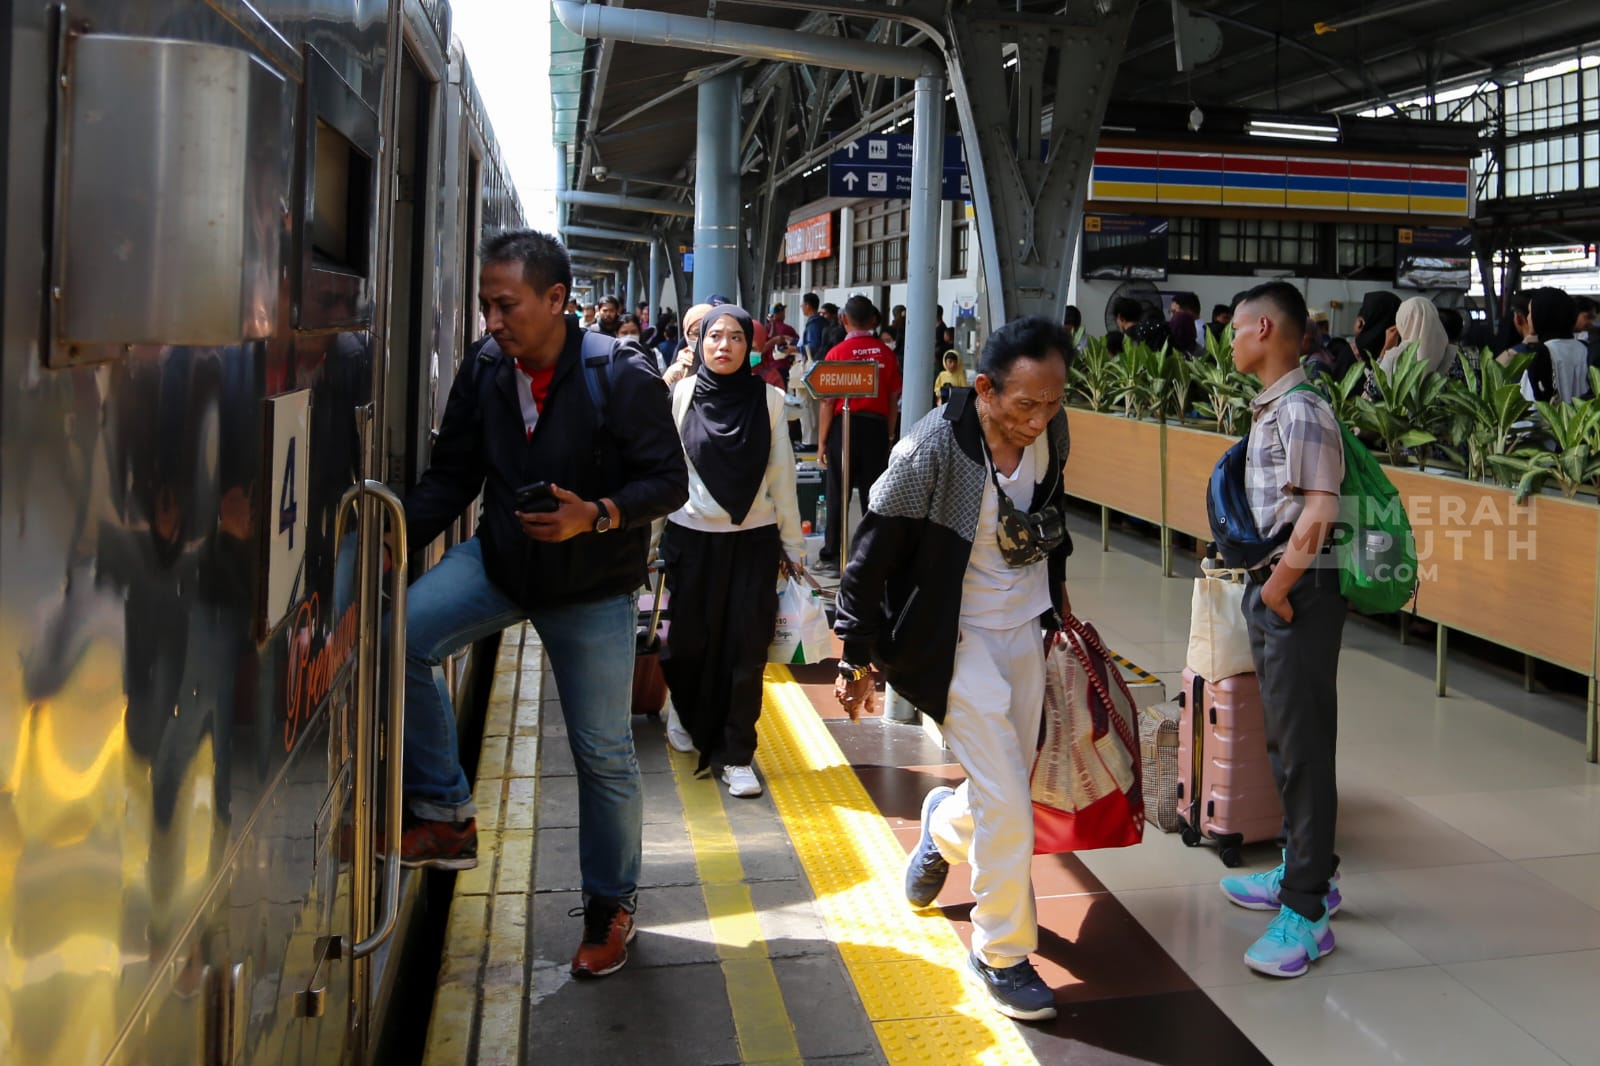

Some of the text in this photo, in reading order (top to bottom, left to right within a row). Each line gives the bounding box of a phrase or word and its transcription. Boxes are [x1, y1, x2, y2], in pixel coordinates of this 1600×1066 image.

[897, 143, 913, 151] Toile
[852, 347, 881, 356] PORTER
[279, 436, 297, 551] 4
